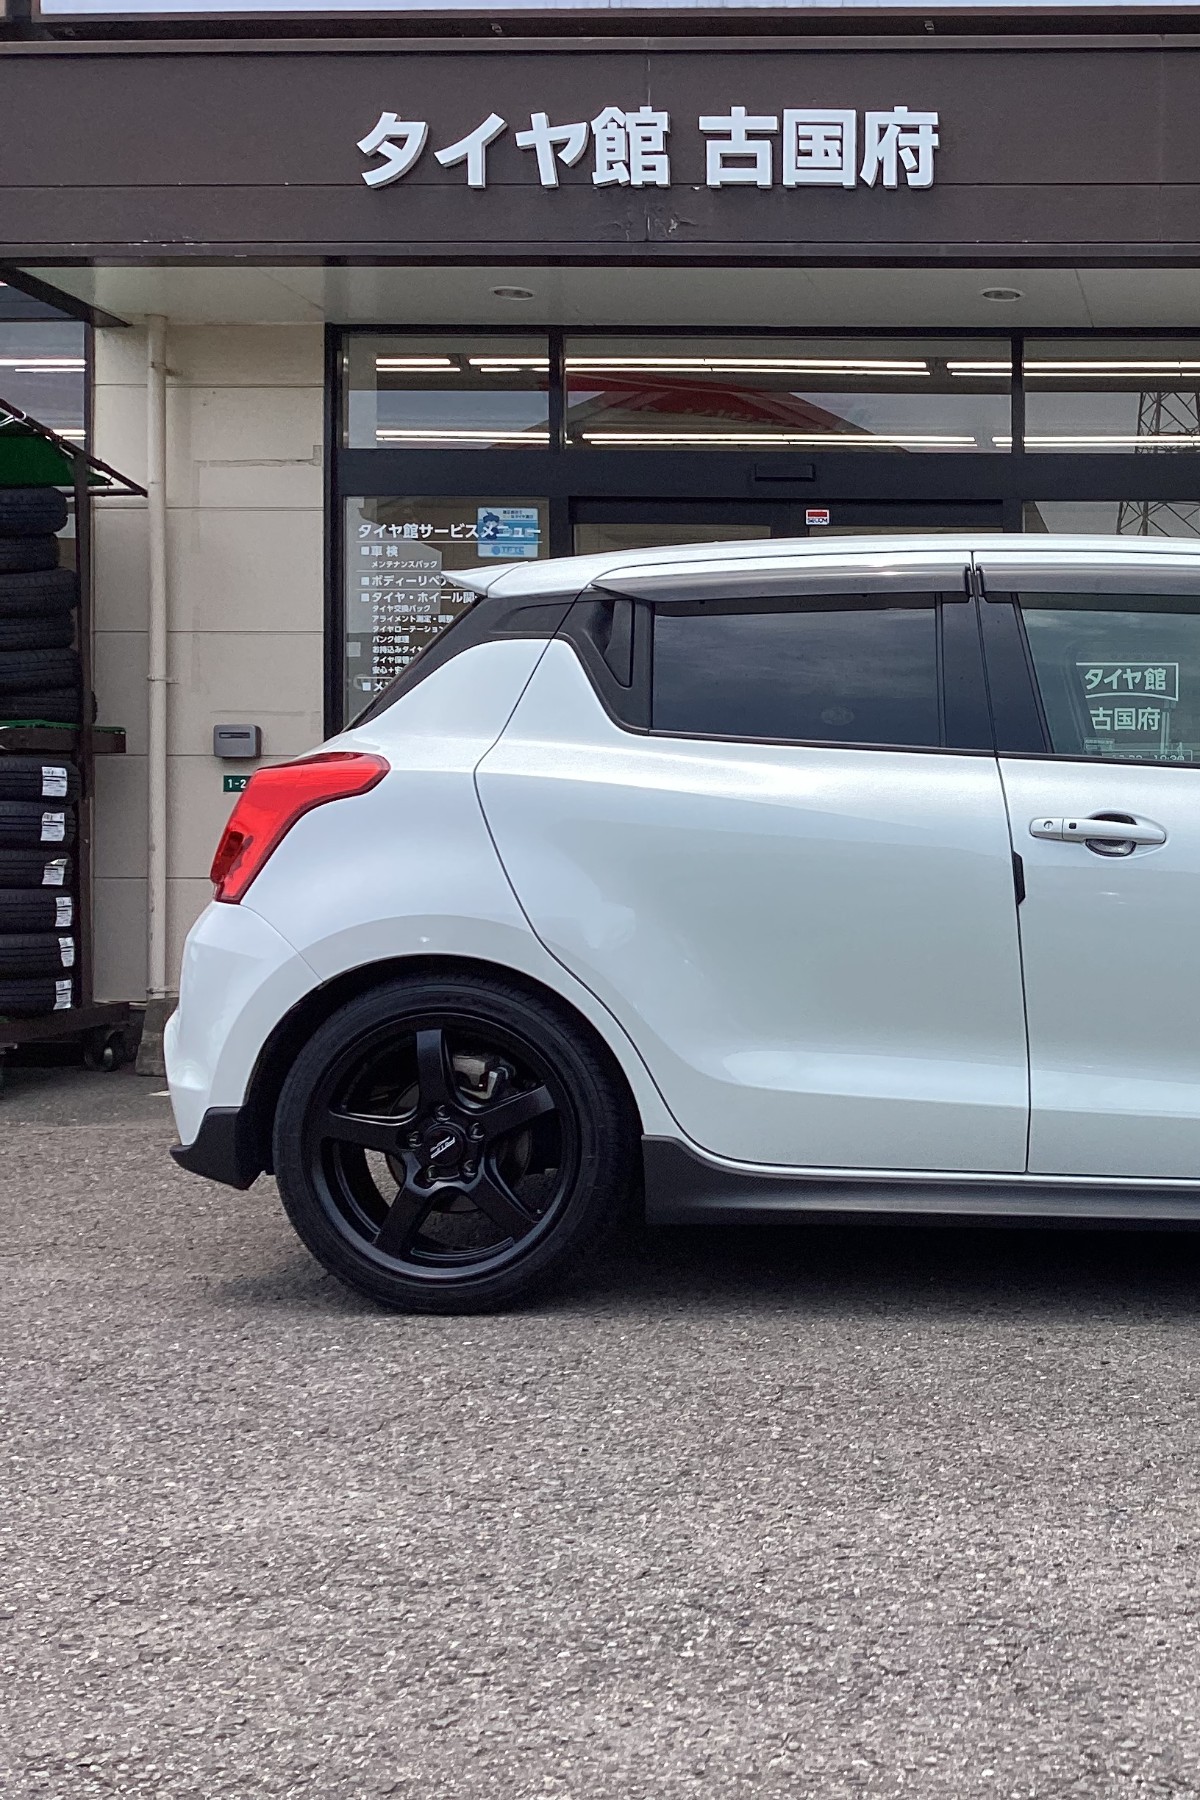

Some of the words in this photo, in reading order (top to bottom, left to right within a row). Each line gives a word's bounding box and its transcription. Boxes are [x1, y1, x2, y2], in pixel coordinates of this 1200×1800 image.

[357, 106, 671, 189] タイヤ館
[698, 106, 939, 189] 古国府
[358, 524, 542, 539] タイヤ館サービスメニュー
[371, 560, 438, 569] メンテナンスパック
[1084, 667, 1167, 691] タイヤ館
[1089, 706, 1161, 731] 古国府
